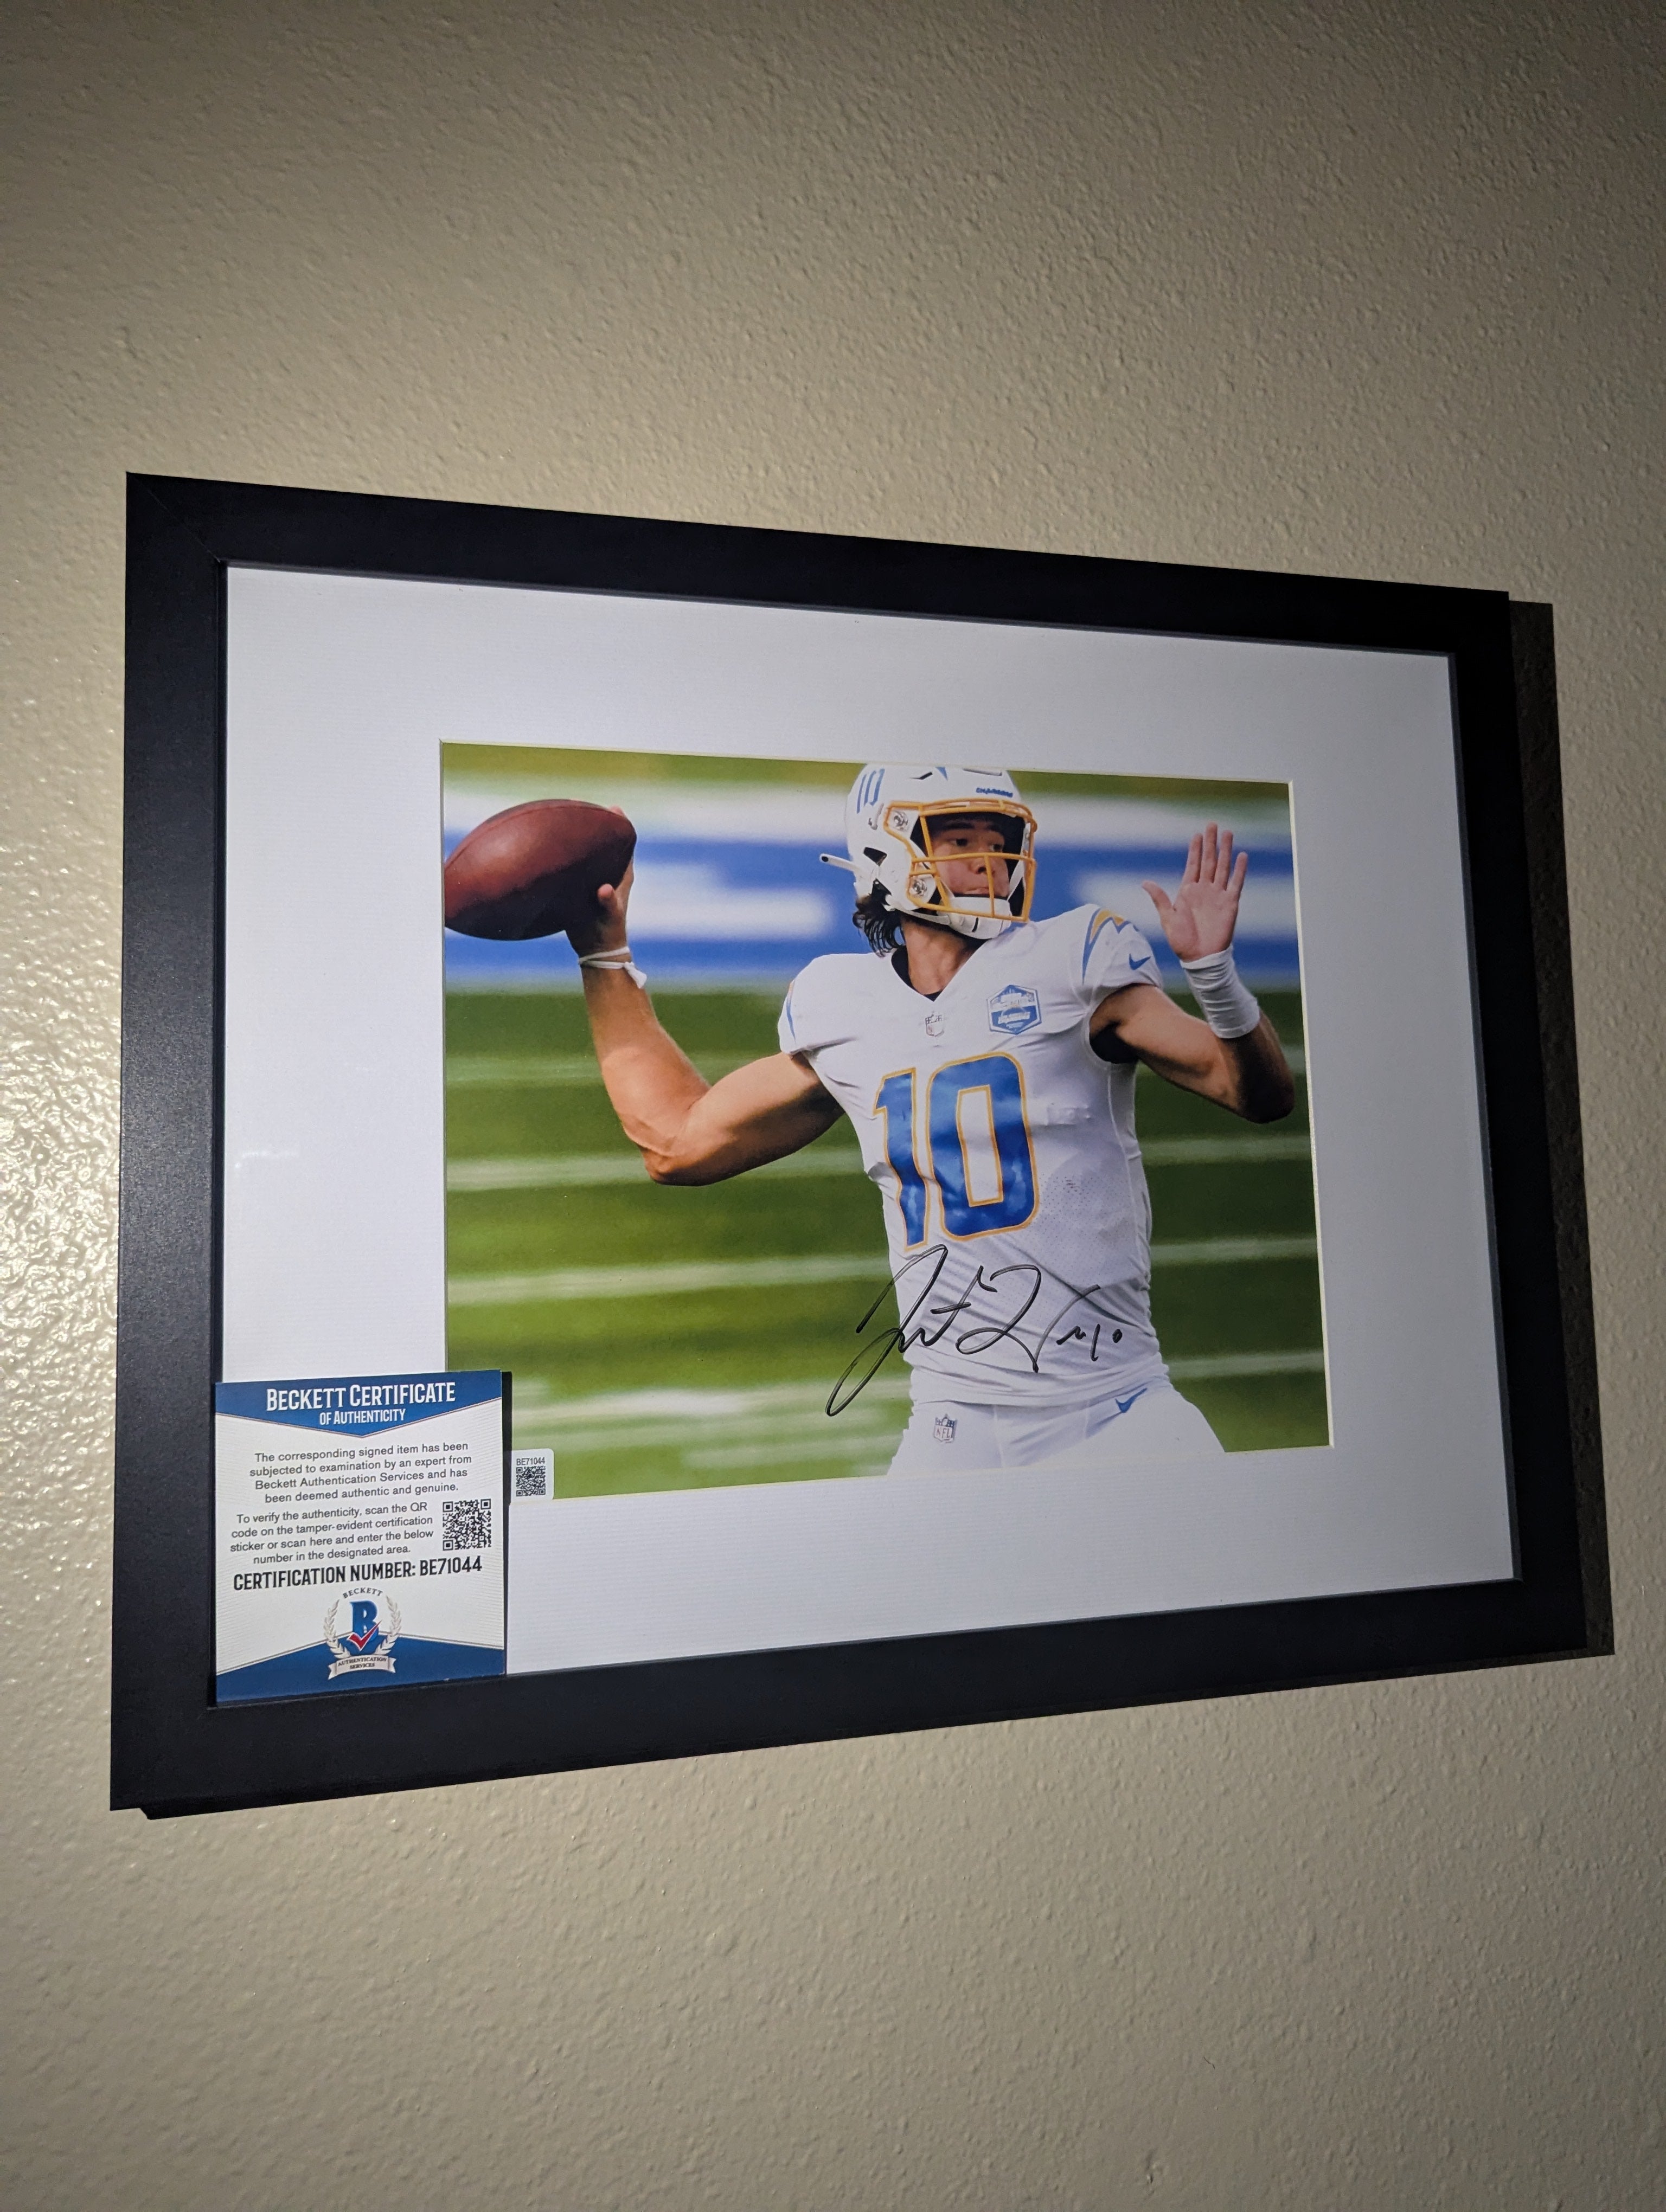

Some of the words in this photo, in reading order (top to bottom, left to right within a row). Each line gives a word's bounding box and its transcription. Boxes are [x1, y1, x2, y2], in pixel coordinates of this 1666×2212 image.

[872, 1051, 1040, 1253] 10
[267, 1387, 347, 1411] BECKETT
[349, 1382, 456, 1407] CERTIFICATE
[319, 1412, 332, 1425] OF
[334, 1409, 406, 1425] AUTHENTICITY
[255, 1453, 274, 1462] The
[278, 1449, 355, 1462] corresponding
[358, 1445, 393, 1458] signed
[396, 1445, 418, 1454] item
[422, 1444, 439, 1452] has
[443, 1442, 468, 1451] been
[516, 1457, 545, 1465] BE71044
[249, 1464, 302, 1478] subjected
[319, 1460, 381, 1472] examination
[385, 1459, 396, 1470] by
[415, 1457, 446, 1468] expert
[448, 1455, 472, 1464] from
[255, 1479, 297, 1490] Beckett
[300, 1475, 376, 1487] Authentication
[380, 1471, 424, 1482] Services
[427, 1469, 446, 1478] and
[450, 1468, 467, 1477] has
[265, 1494, 292, 1503] been
[295, 1489, 338, 1501] deemed
[342, 1486, 389, 1498] authentic
[393, 1484, 412, 1495] and
[415, 1483, 459, 1495] genuine.
[236, 1514, 250, 1523] To
[253, 1512, 280, 1523] verify
[283, 1511, 299, 1520] the
[302, 1507, 362, 1519] authenticity,
[365, 1507, 389, 1515] scan
[392, 1503, 407, 1512] the
[410, 1502, 427, 1512] QR
[231, 1528, 258, 1538] code
[277, 1525, 293, 1535] the
[375, 1516, 433, 1528] certification
[230, 1541, 265, 1552] sticker
[280, 1540, 306, 1548] scan
[310, 1537, 332, 1546] here
[335, 1534, 354, 1544] and
[357, 1533, 383, 1543] enter
[385, 1531, 401, 1540] the
[404, 1529, 434, 1539] below
[253, 1553, 293, 1564] number
[296, 1552, 305, 1561] in
[308, 1550, 324, 1560] the
[327, 1545, 383, 1559] designated
[386, 1546, 411, 1554] area.
[234, 1566, 345, 1591] CERTIFICATION
[350, 1561, 415, 1582] NUMBER:
[420, 1556, 482, 1580] BE71044
[343, 1587, 383, 1599] BECKETT
[349, 1600, 379, 1642] B
[338, 1656, 388, 1667] AUTHENTICATION
